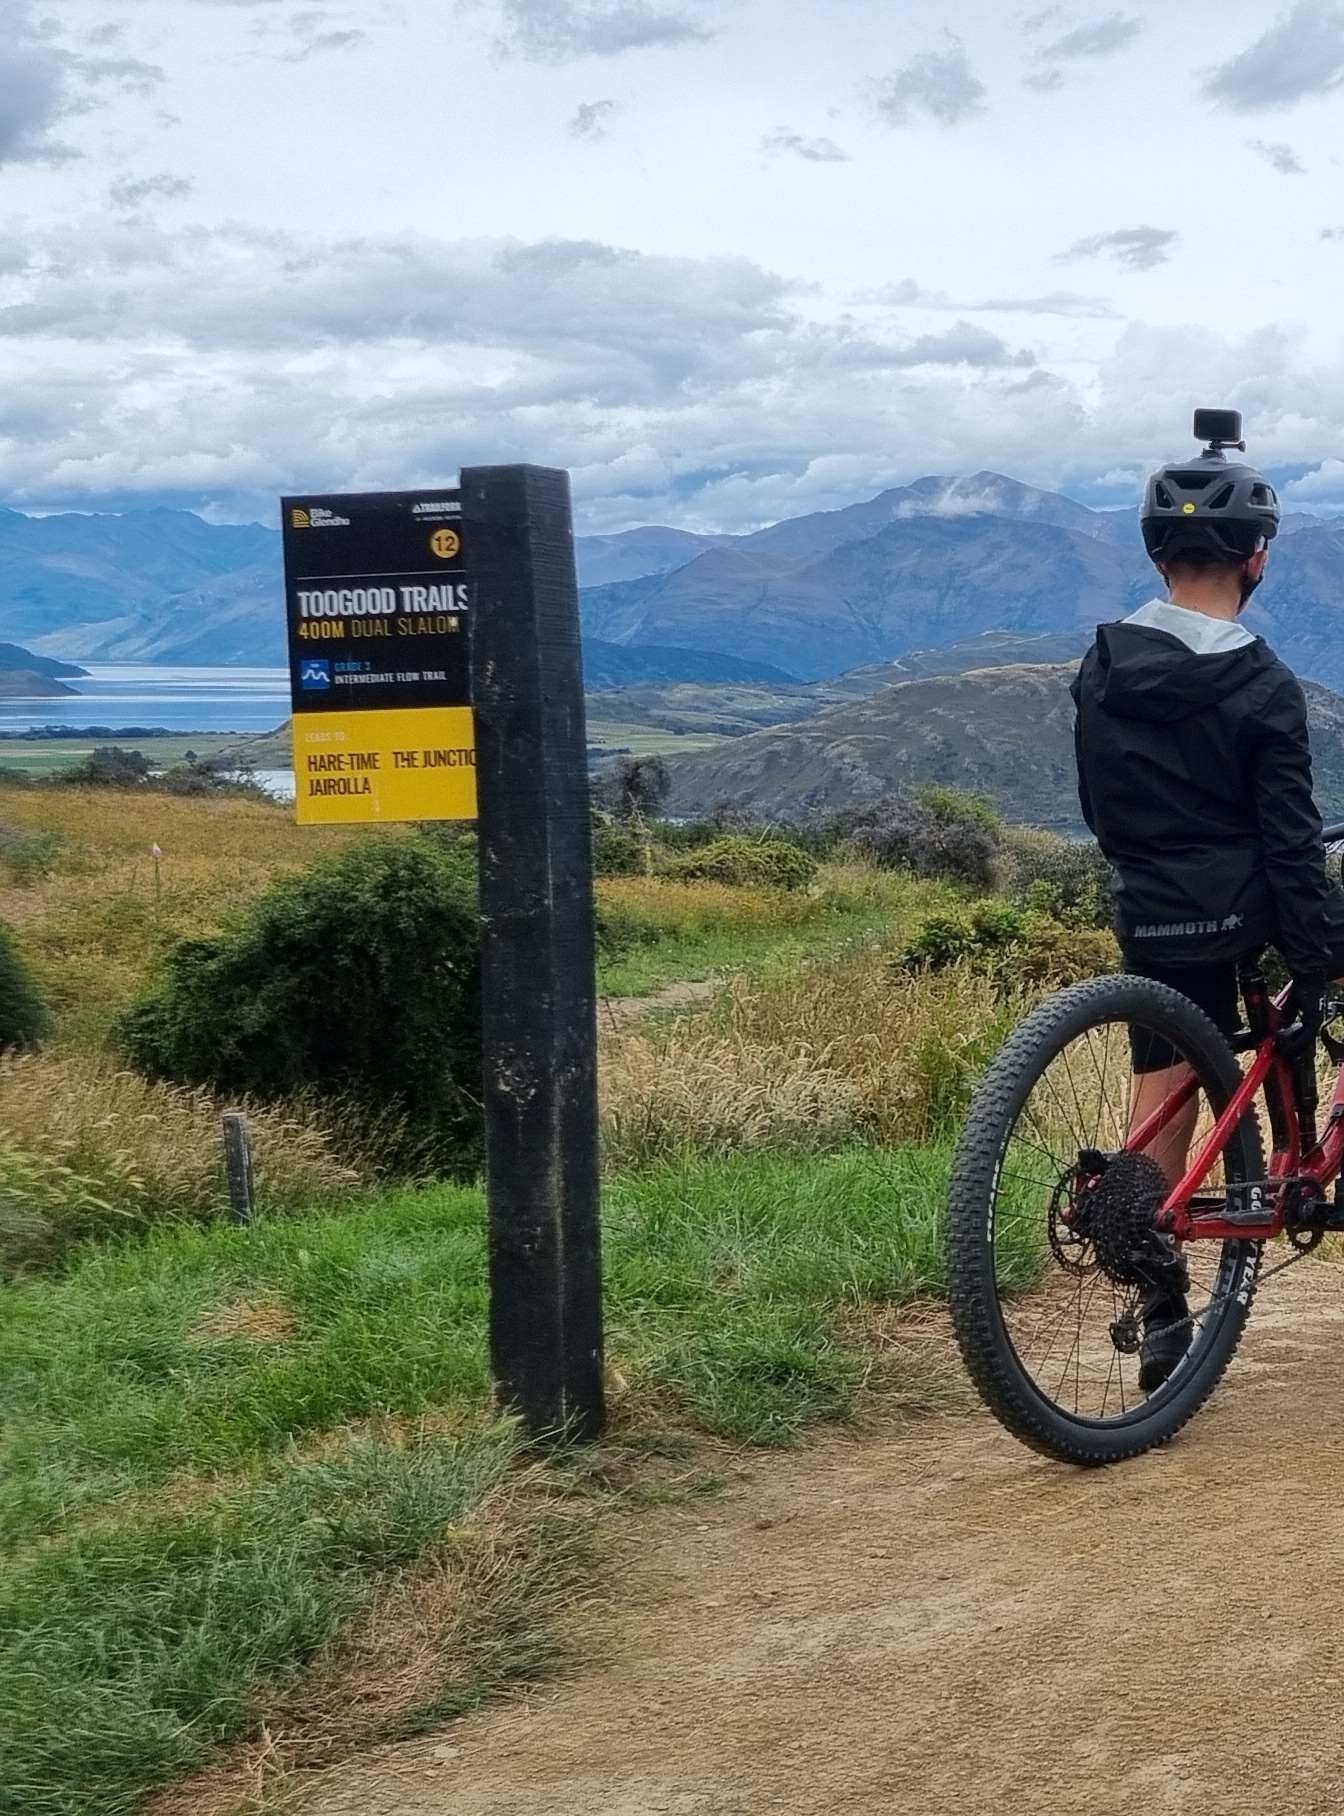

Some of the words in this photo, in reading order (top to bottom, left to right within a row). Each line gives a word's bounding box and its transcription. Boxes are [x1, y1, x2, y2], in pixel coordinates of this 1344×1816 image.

[434, 535, 456, 552] 12
[297, 587, 396, 618] TOOGOOD
[400, 585, 469, 613] TRAILS
[299, 621, 345, 640] 400M
[351, 619, 393, 638] DUAL
[398, 616, 461, 636] SLALOM
[334, 672, 395, 685] INTERMEDIATE
[397, 672, 420, 682] FLOW
[422, 671, 448, 681] TRAIL
[307, 752, 381, 772] HARE-TIME
[392, 751, 419, 768] THE
[423, 748, 477, 768] JUNCTIO
[308, 777, 372, 796] JAIROLLA
[1134, 920, 1218, 938] MAMMOTH
